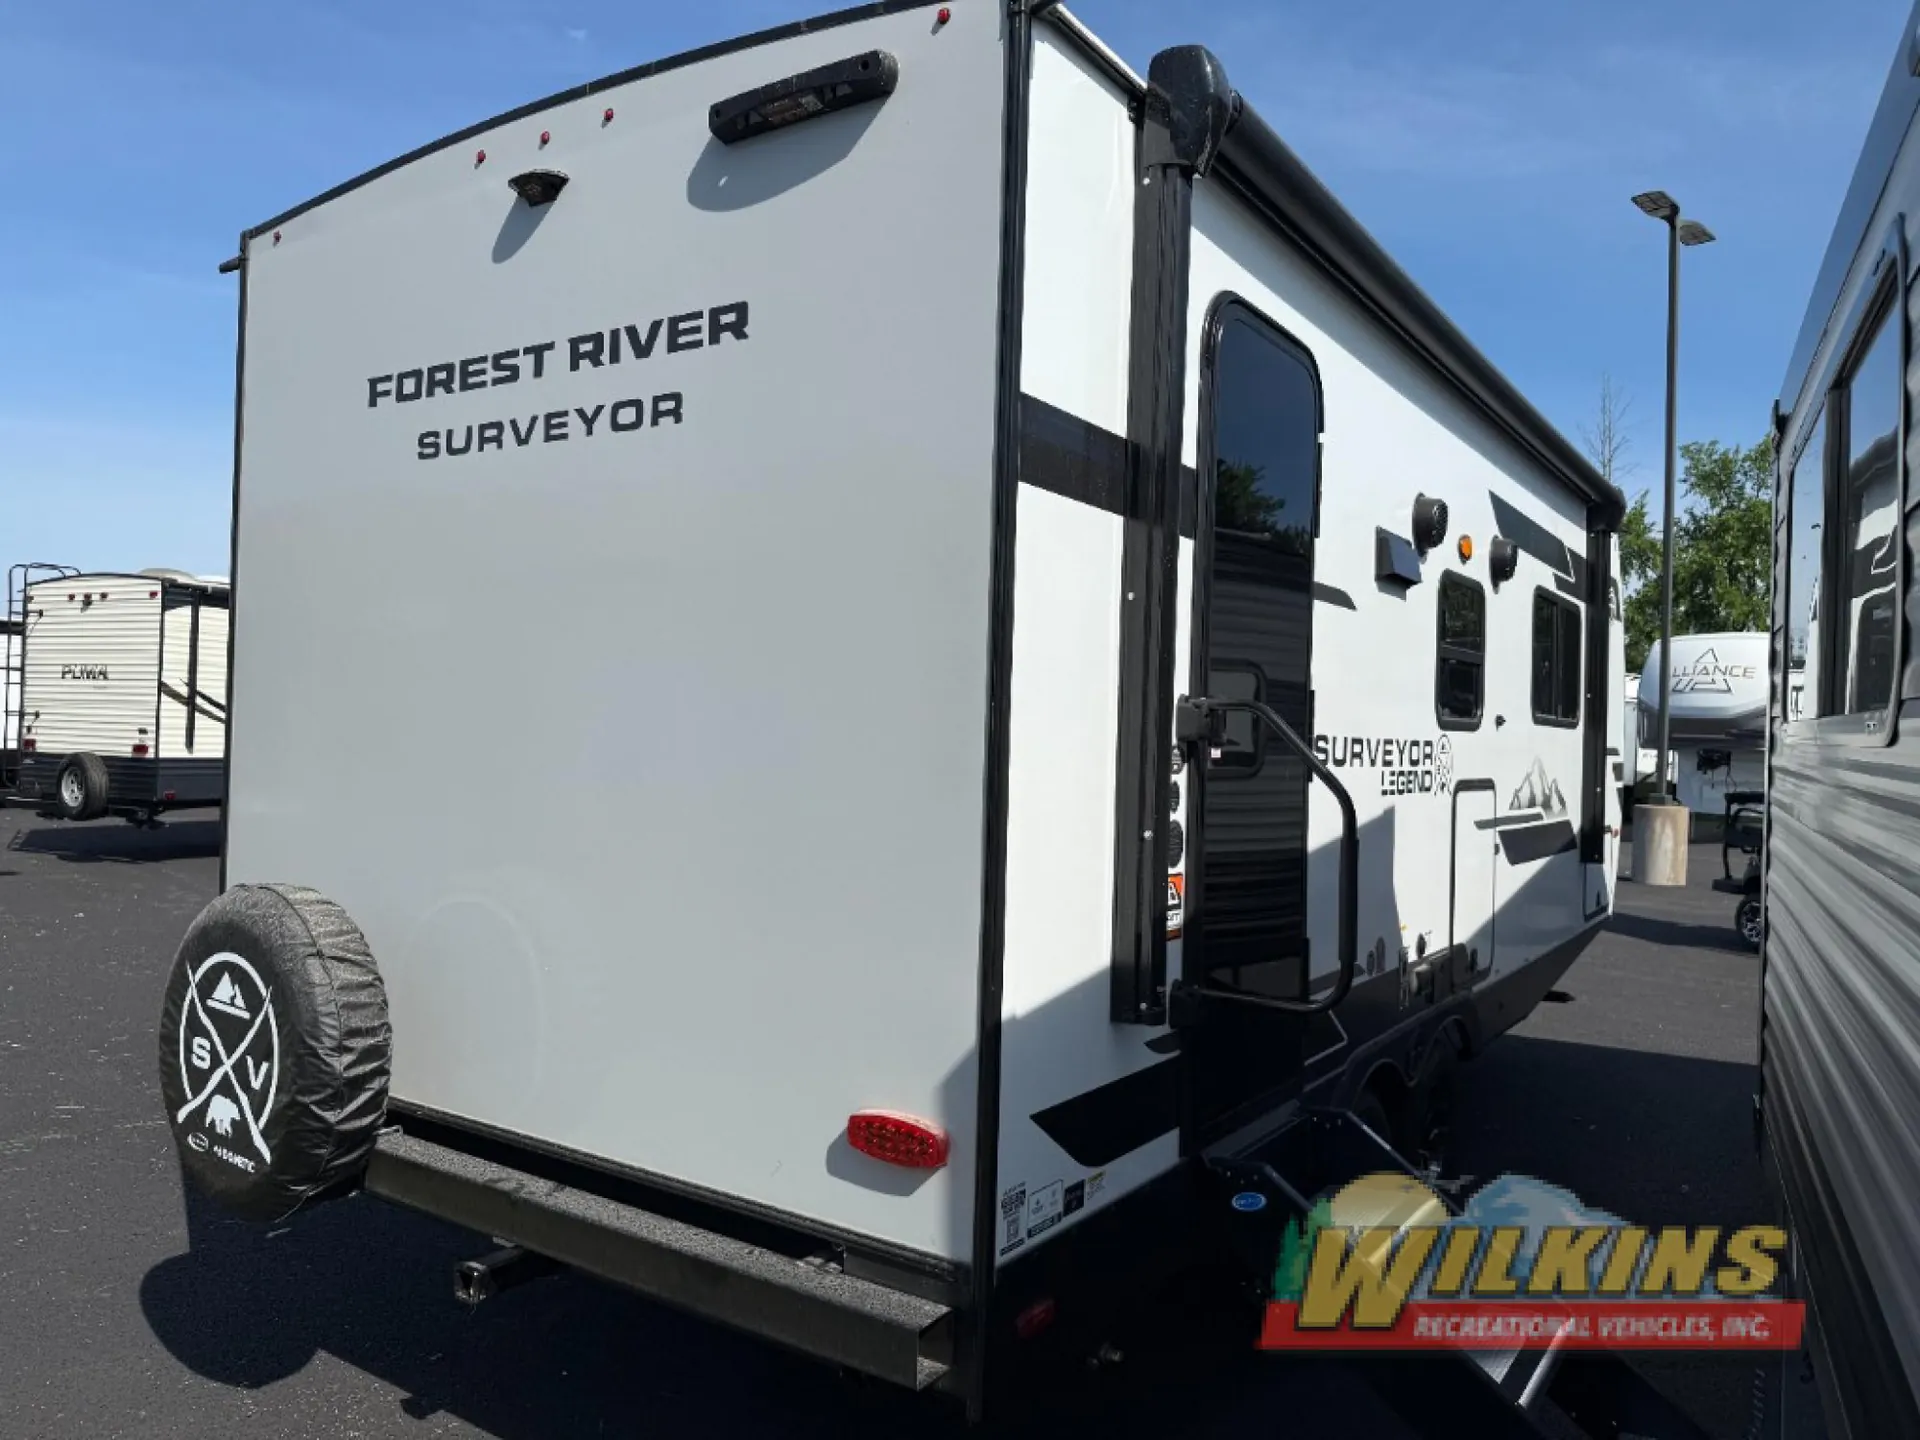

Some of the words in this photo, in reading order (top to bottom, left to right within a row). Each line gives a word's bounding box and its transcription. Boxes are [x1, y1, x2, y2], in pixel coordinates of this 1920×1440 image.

[367, 341, 556, 408] FOREST
[568, 301, 750, 372] RIVER
[417, 391, 684, 460] SURVEYOR
[1314, 734, 1433, 767] SURVEYOR
[1381, 770, 1433, 796] LEGEND
